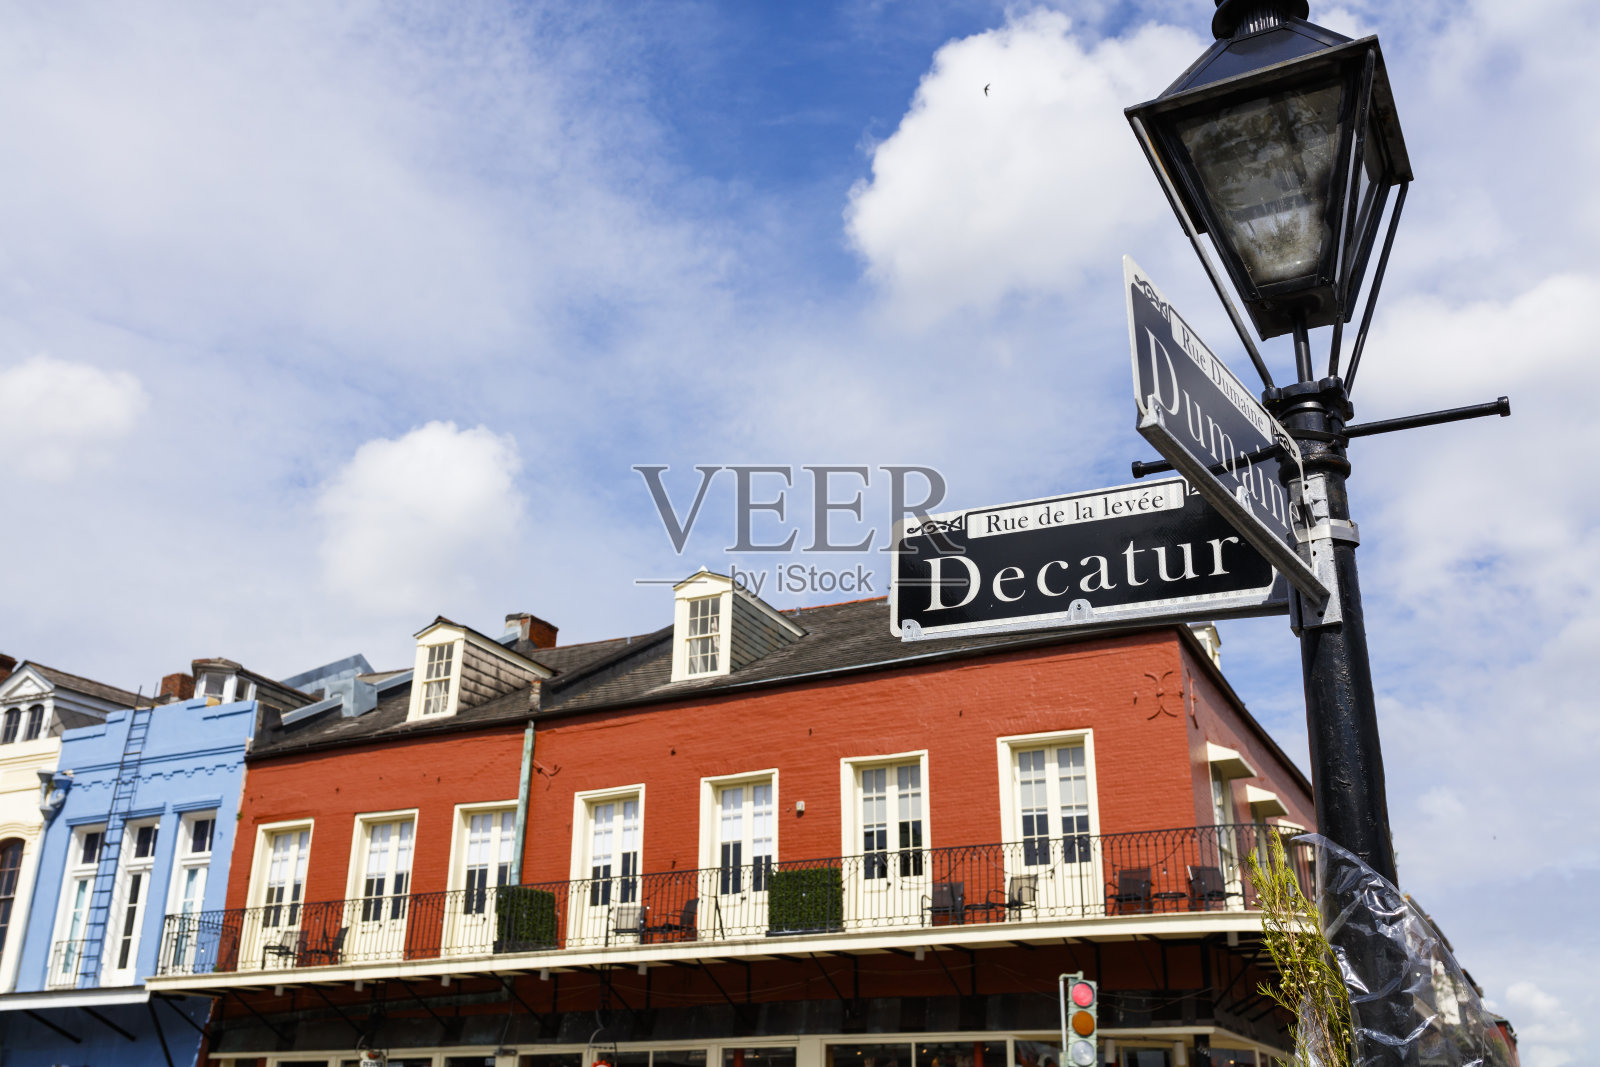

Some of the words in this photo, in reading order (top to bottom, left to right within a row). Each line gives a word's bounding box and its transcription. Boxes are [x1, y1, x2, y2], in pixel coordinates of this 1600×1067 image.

[1181, 325, 1207, 371] Rue
[1210, 358, 1264, 432] Dumaine
[1145, 326, 1304, 543] Dumaine
[986, 515, 1029, 534] Rue
[1038, 506, 1066, 526] de
[1075, 502, 1094, 521] la
[1103, 491, 1164, 516] levée
[923, 536, 1239, 612] Decatur
